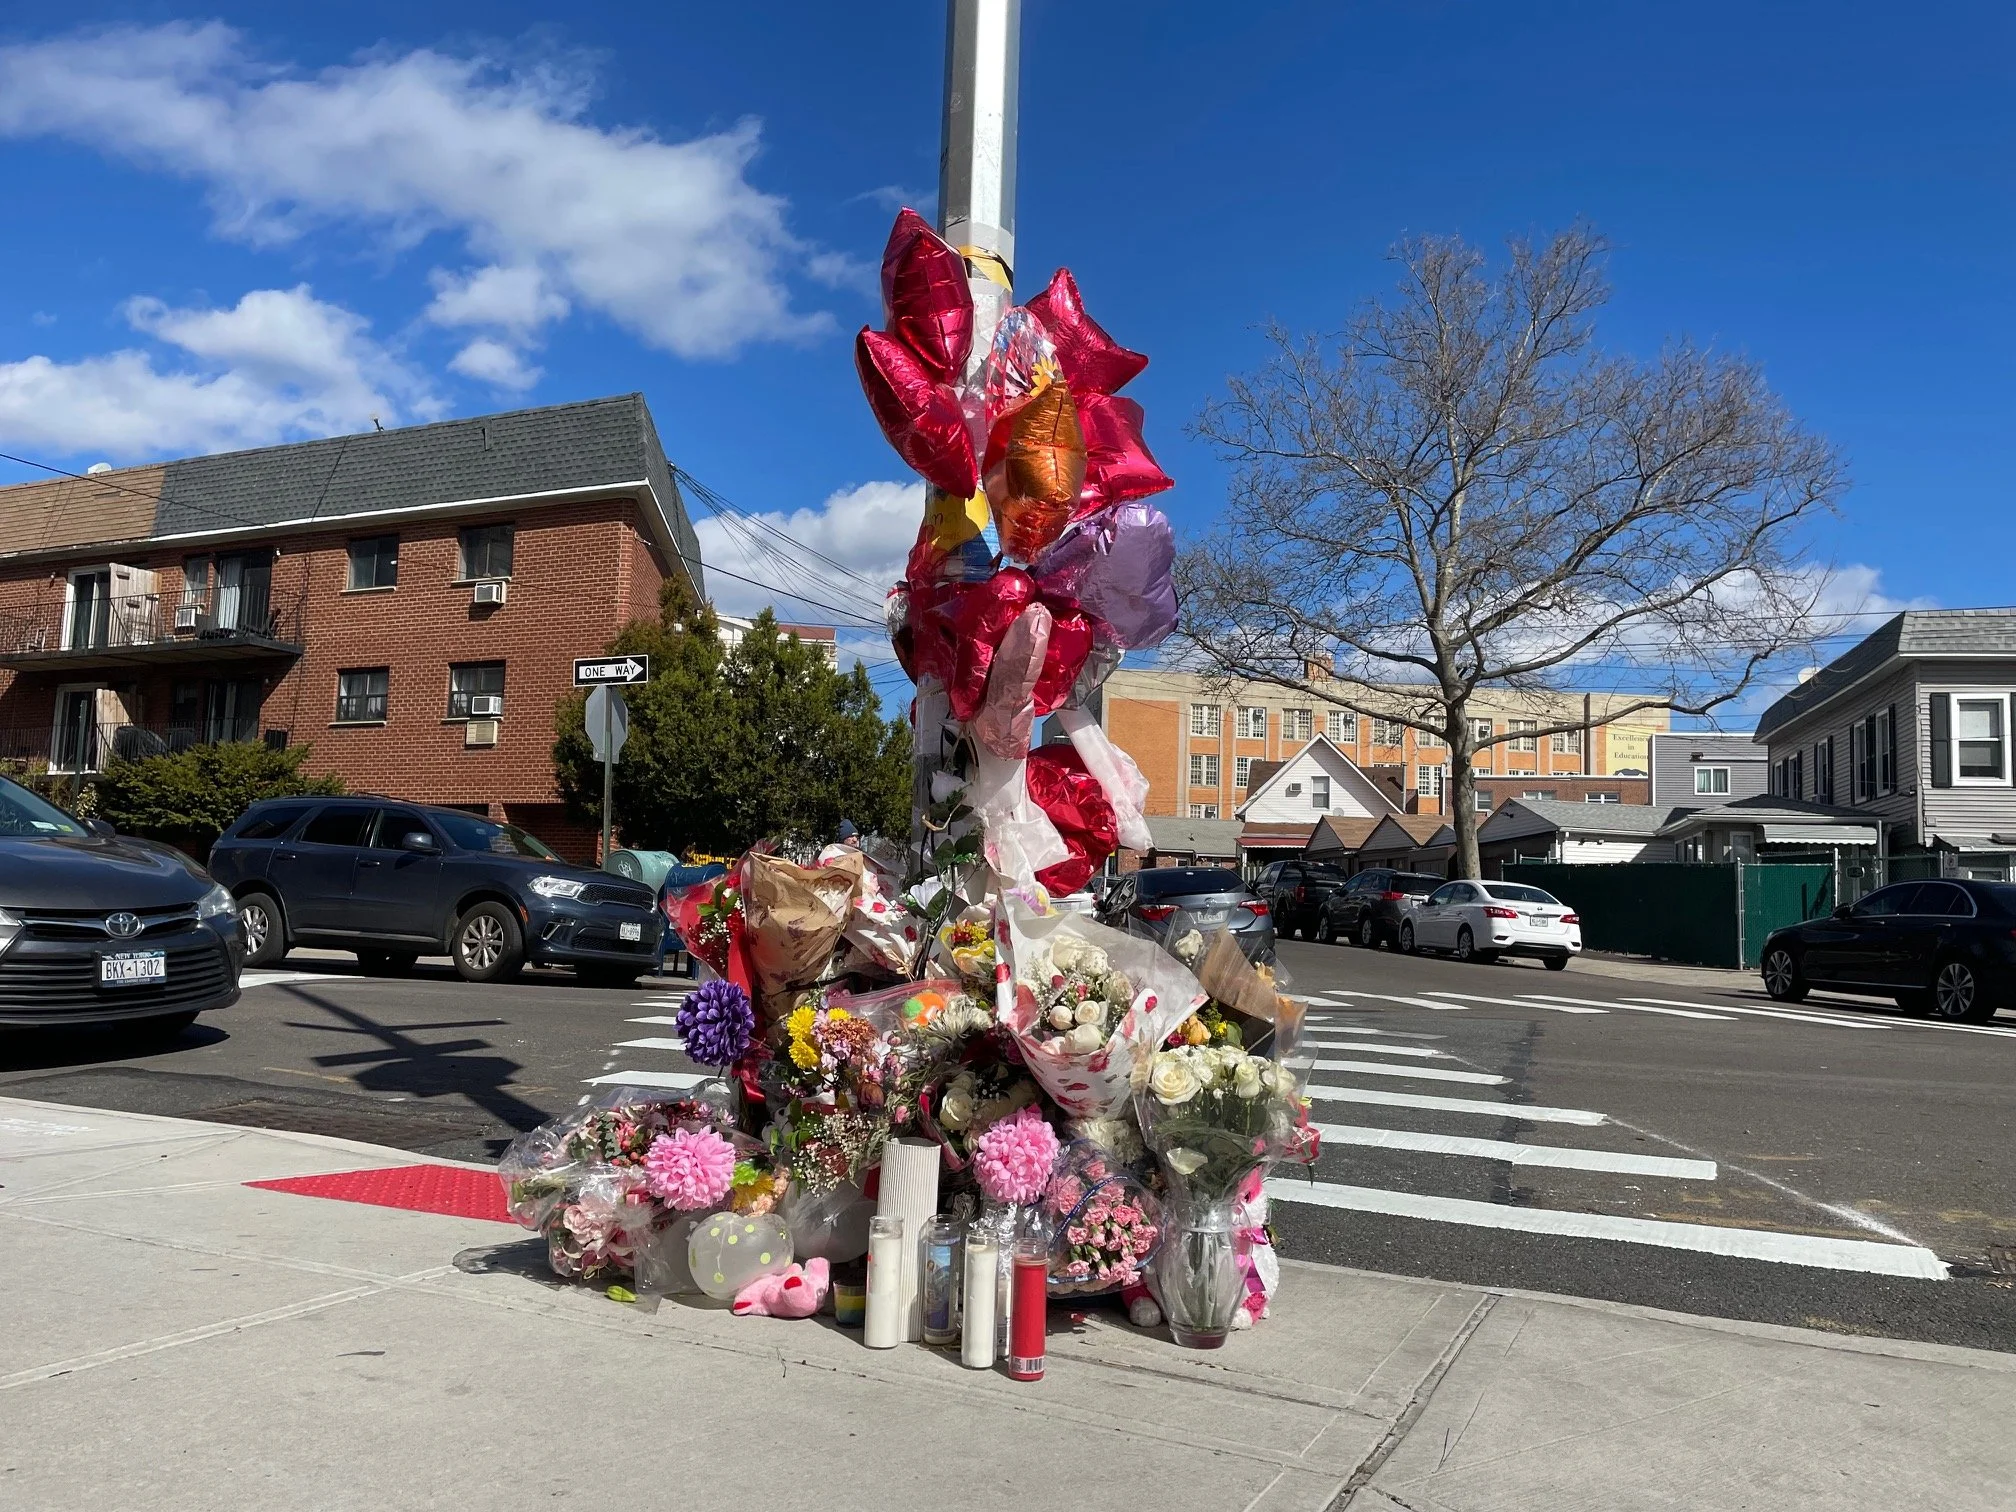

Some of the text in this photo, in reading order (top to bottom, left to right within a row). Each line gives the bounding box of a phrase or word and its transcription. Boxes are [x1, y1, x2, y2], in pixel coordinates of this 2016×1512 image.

[585, 665, 636, 677] ONE WAY
[106, 959, 160, 979] BKX 1302
